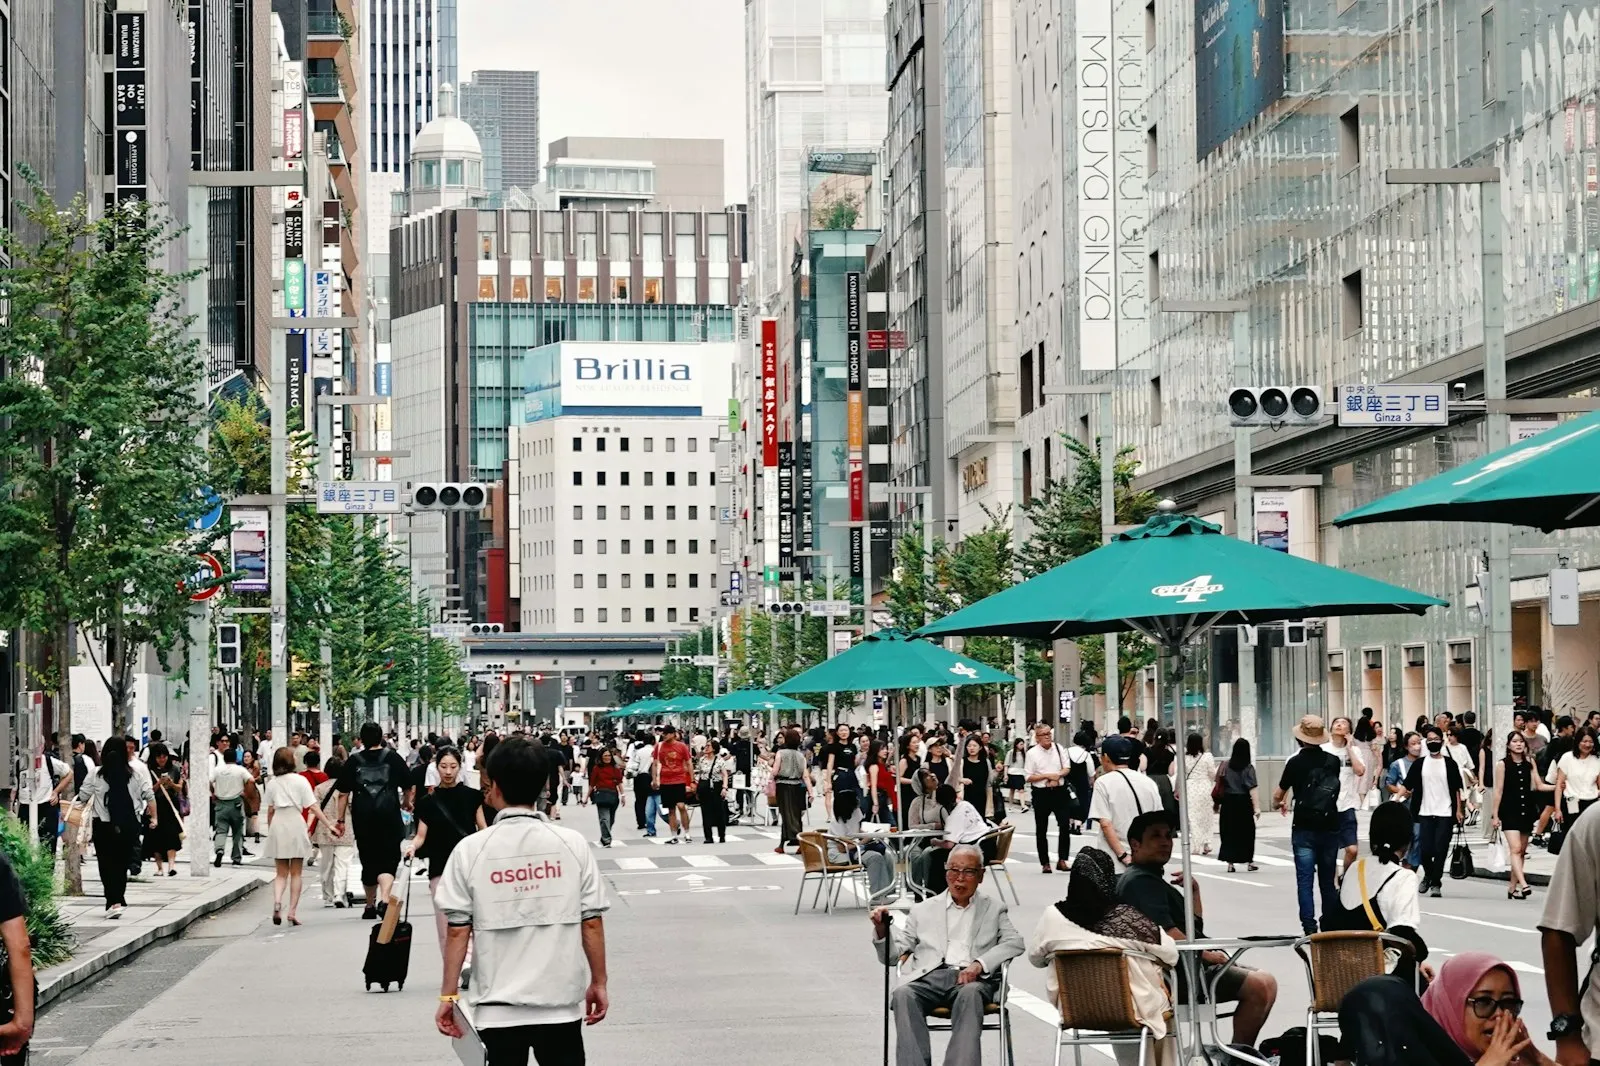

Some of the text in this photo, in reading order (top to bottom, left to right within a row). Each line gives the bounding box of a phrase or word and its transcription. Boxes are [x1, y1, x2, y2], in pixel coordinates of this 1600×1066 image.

[121, 25, 129, 57] BUILDING
[132, 16, 140, 58] MATSUZAWA
[127, 84, 136, 99] NO
[137, 84, 145, 104] FUJI
[811, 153, 843, 162] YOMIKO
[285, 216, 294, 247] BEAUTY
[293, 216, 302, 247] CLINIC
[849, 275, 858, 318] KOMEHYO
[573, 357, 692, 381] Brillia
[290, 357, 299, 408] I-PRIMO
[1346, 385, 1376, 394] 中央区
[1346, 394, 1441, 412] 銀座三丁目
[1374, 412, 1412, 423] Ginza 3
[323, 489, 396, 502] 銀座三丁目
[344, 502, 366, 511] Ginza
[852, 530, 861, 573] KOMEHYO
[1152, 583, 1223, 597] Ginza
[1176, 574, 1213, 604] 4
[490, 860, 562, 884] asaichi
[513, 884, 541, 893] STAFF
